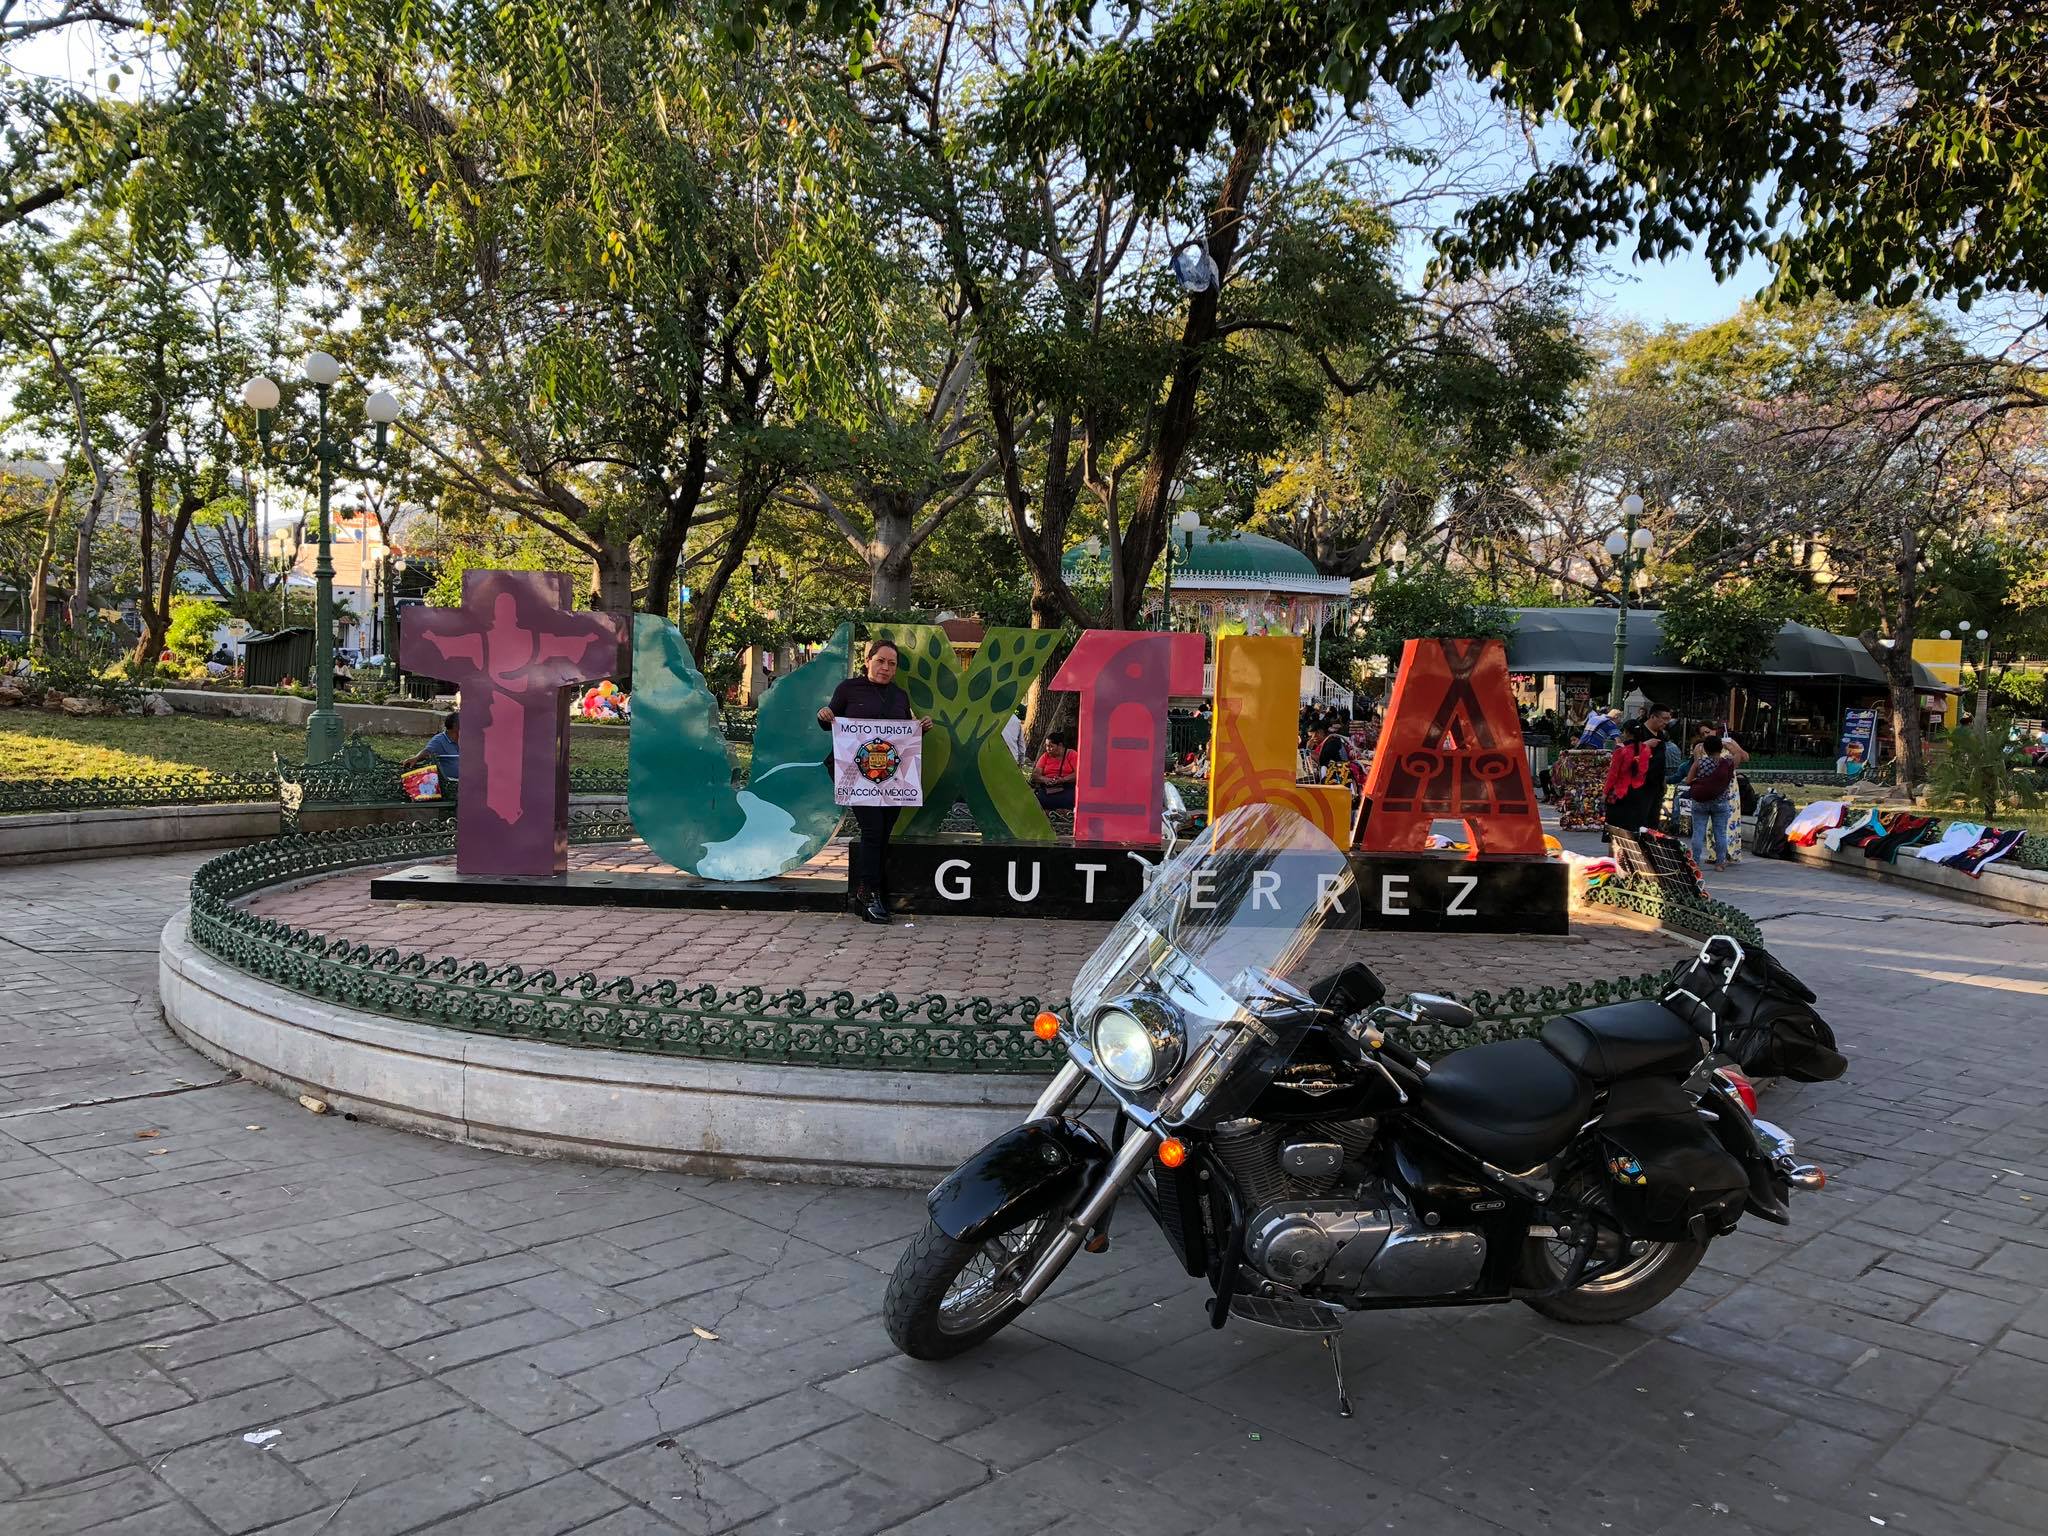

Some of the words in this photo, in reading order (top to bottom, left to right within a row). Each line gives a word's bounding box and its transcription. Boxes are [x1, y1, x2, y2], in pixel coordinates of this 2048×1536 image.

[841, 724, 872, 734] MOTO
[874, 725, 913, 735] TURISTA
[837, 787, 849, 797] EN
[850, 786, 883, 797] ACCIÓN
[884, 786, 918, 797] MÉXICO
[934, 859, 1478, 915] GUTERREZ
